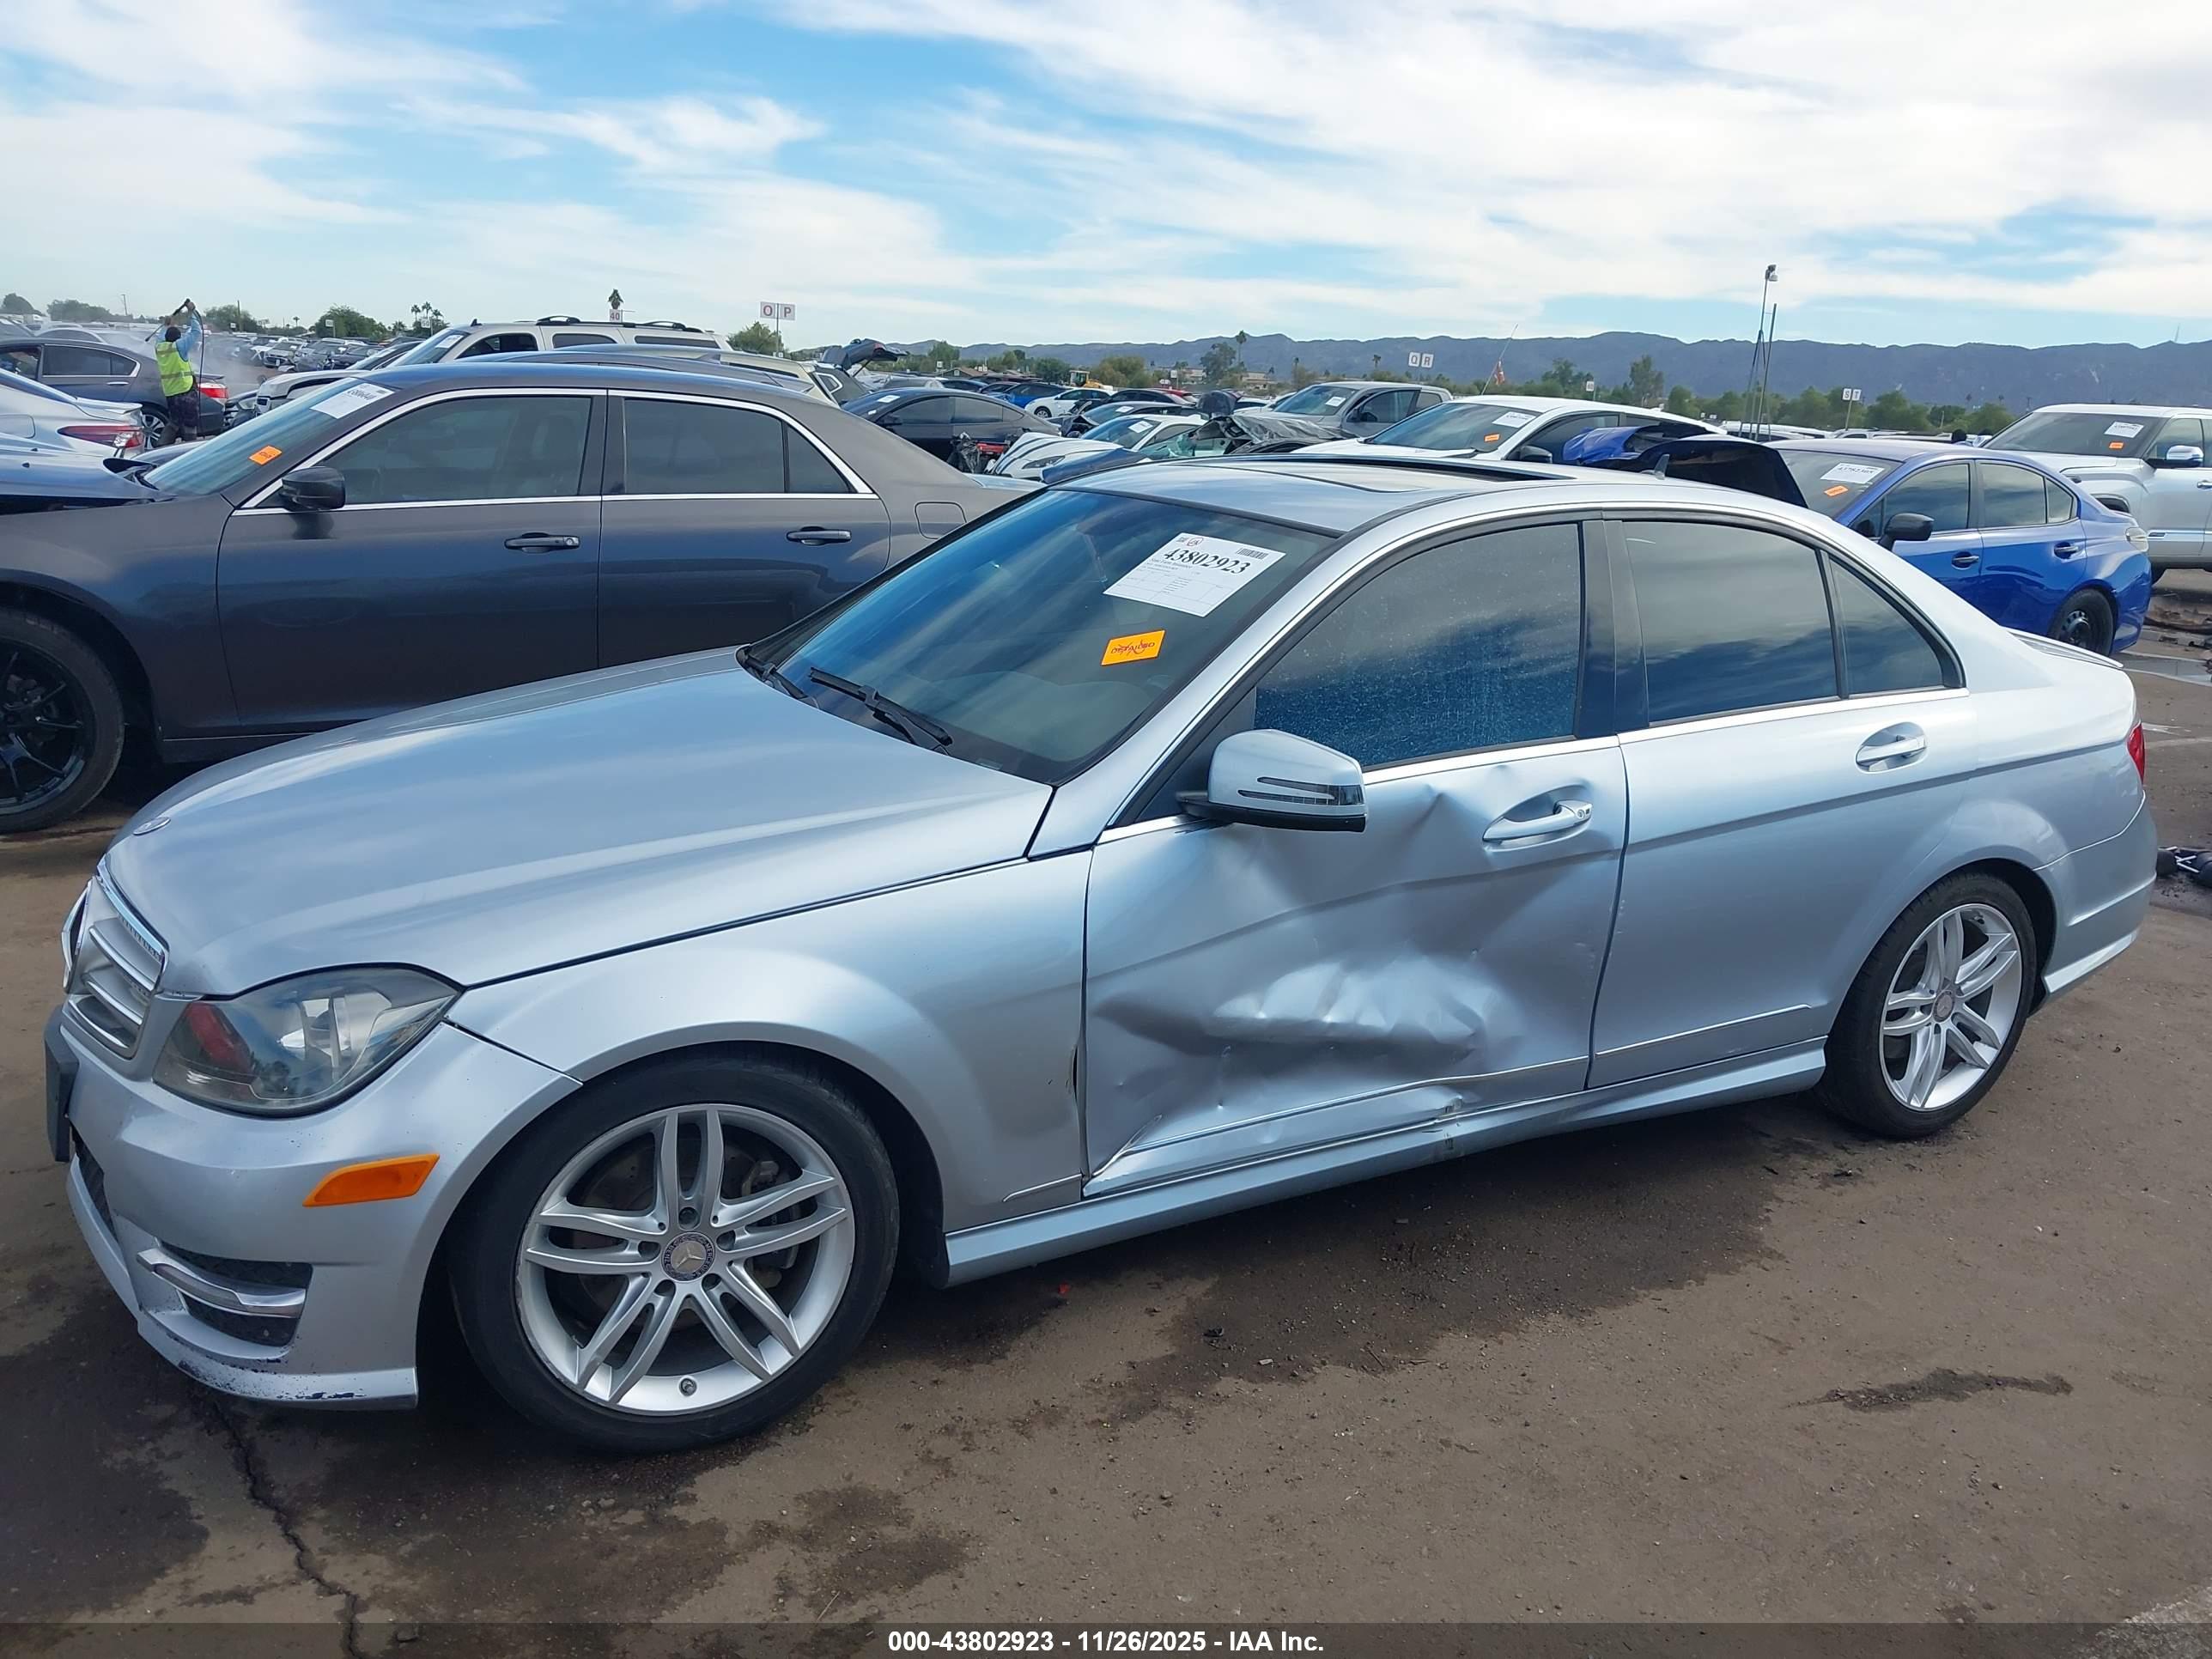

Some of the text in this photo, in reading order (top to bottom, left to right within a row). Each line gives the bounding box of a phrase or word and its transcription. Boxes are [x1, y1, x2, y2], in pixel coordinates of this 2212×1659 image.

[610, 312, 620, 320] 40
[783, 307, 792, 318] P
[1424, 356, 1431, 366] R
[1164, 548, 1251, 574] 43802923
